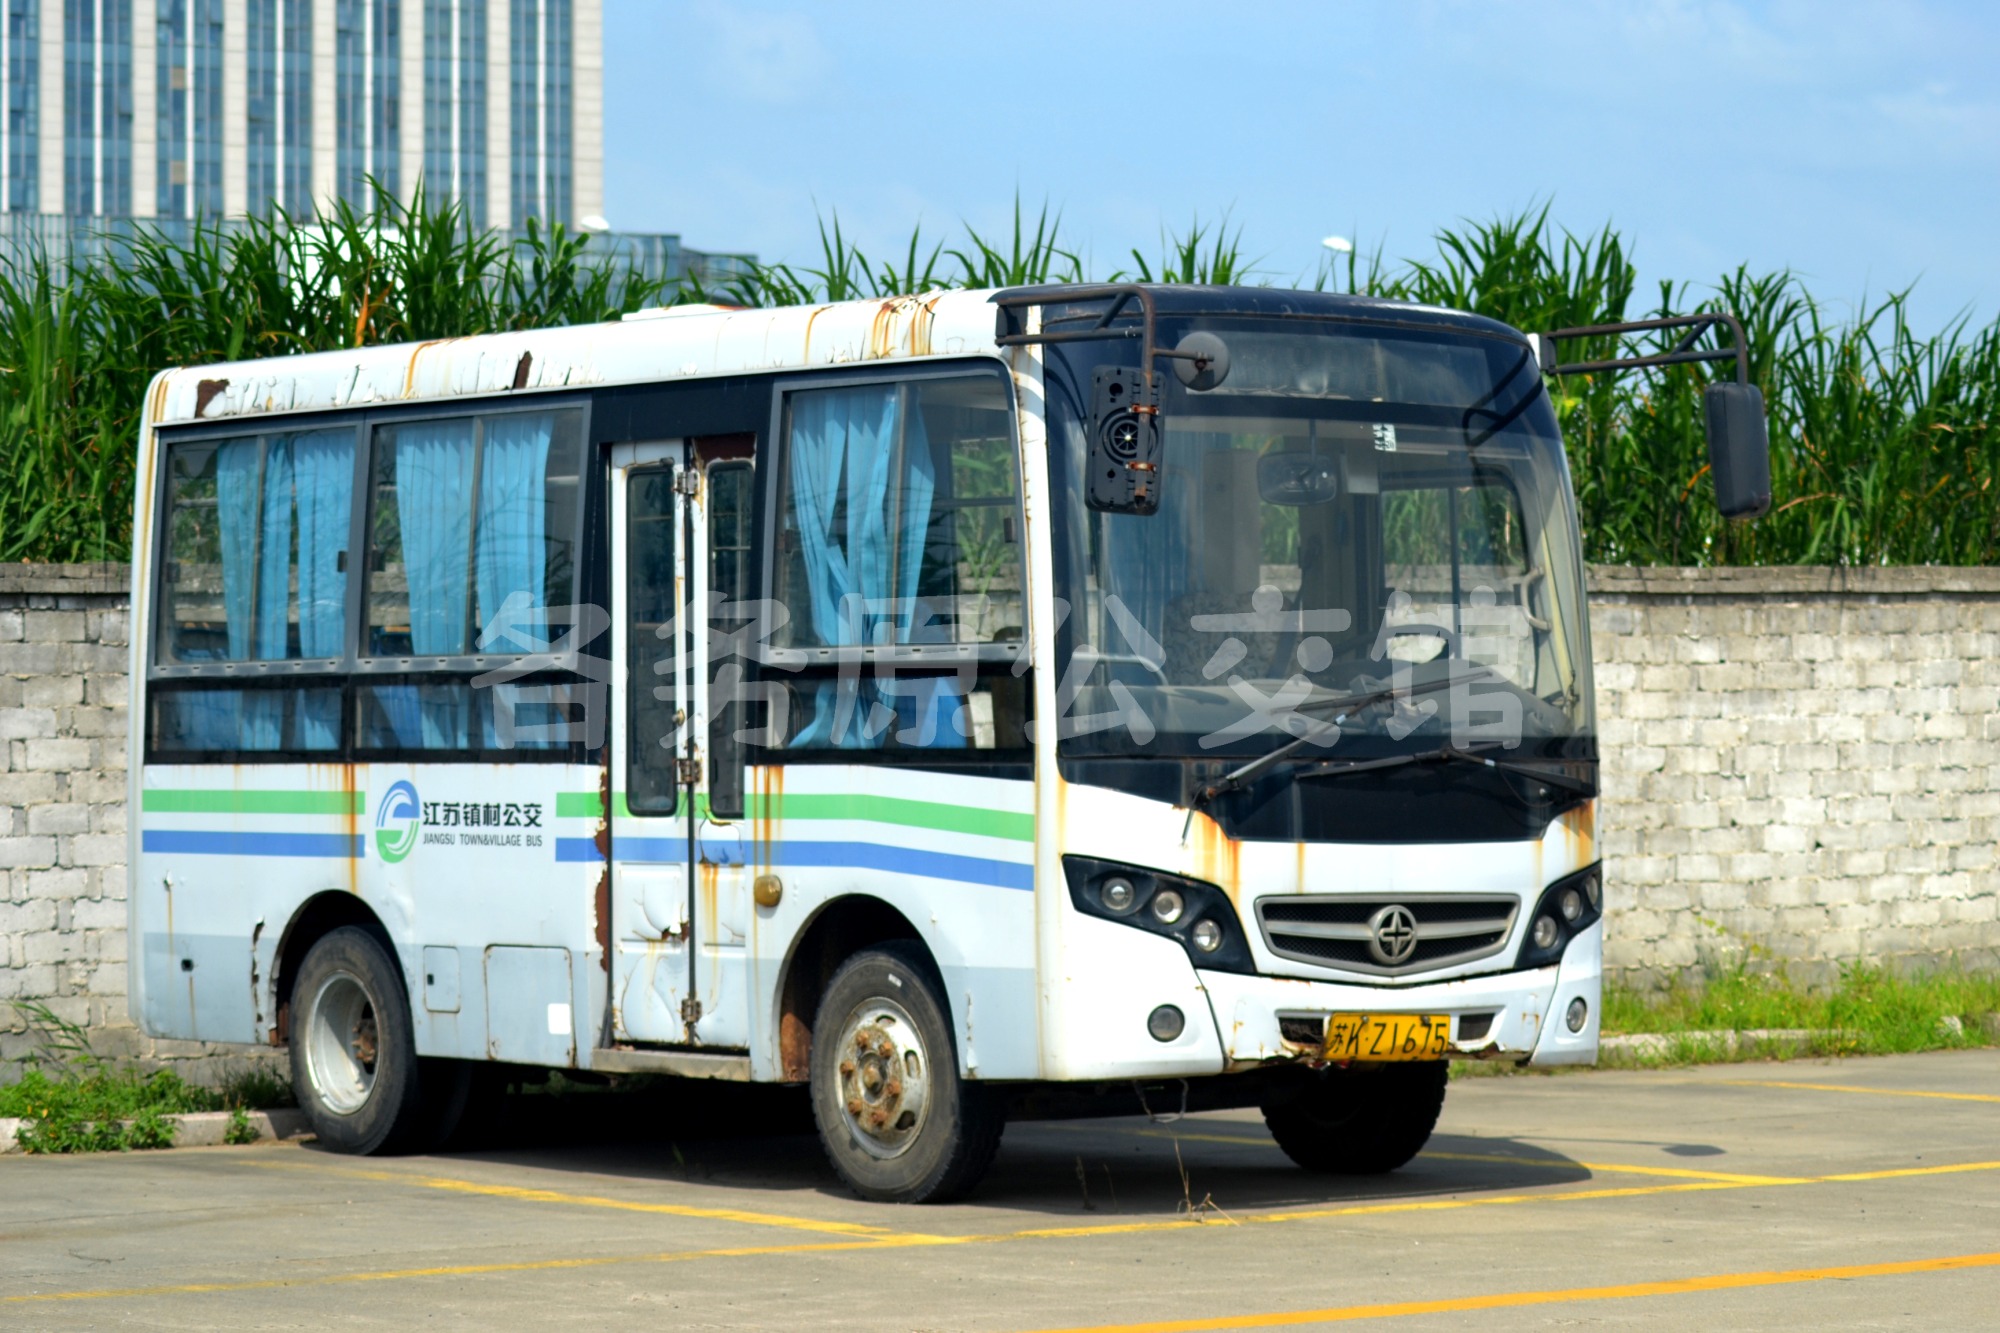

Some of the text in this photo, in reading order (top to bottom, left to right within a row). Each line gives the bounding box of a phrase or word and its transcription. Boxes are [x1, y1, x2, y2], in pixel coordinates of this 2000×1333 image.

[423, 802, 542, 827] 江苏镇村公交
[423, 833, 542, 847] JIANGSU TOWN&VILLAGE BUS
